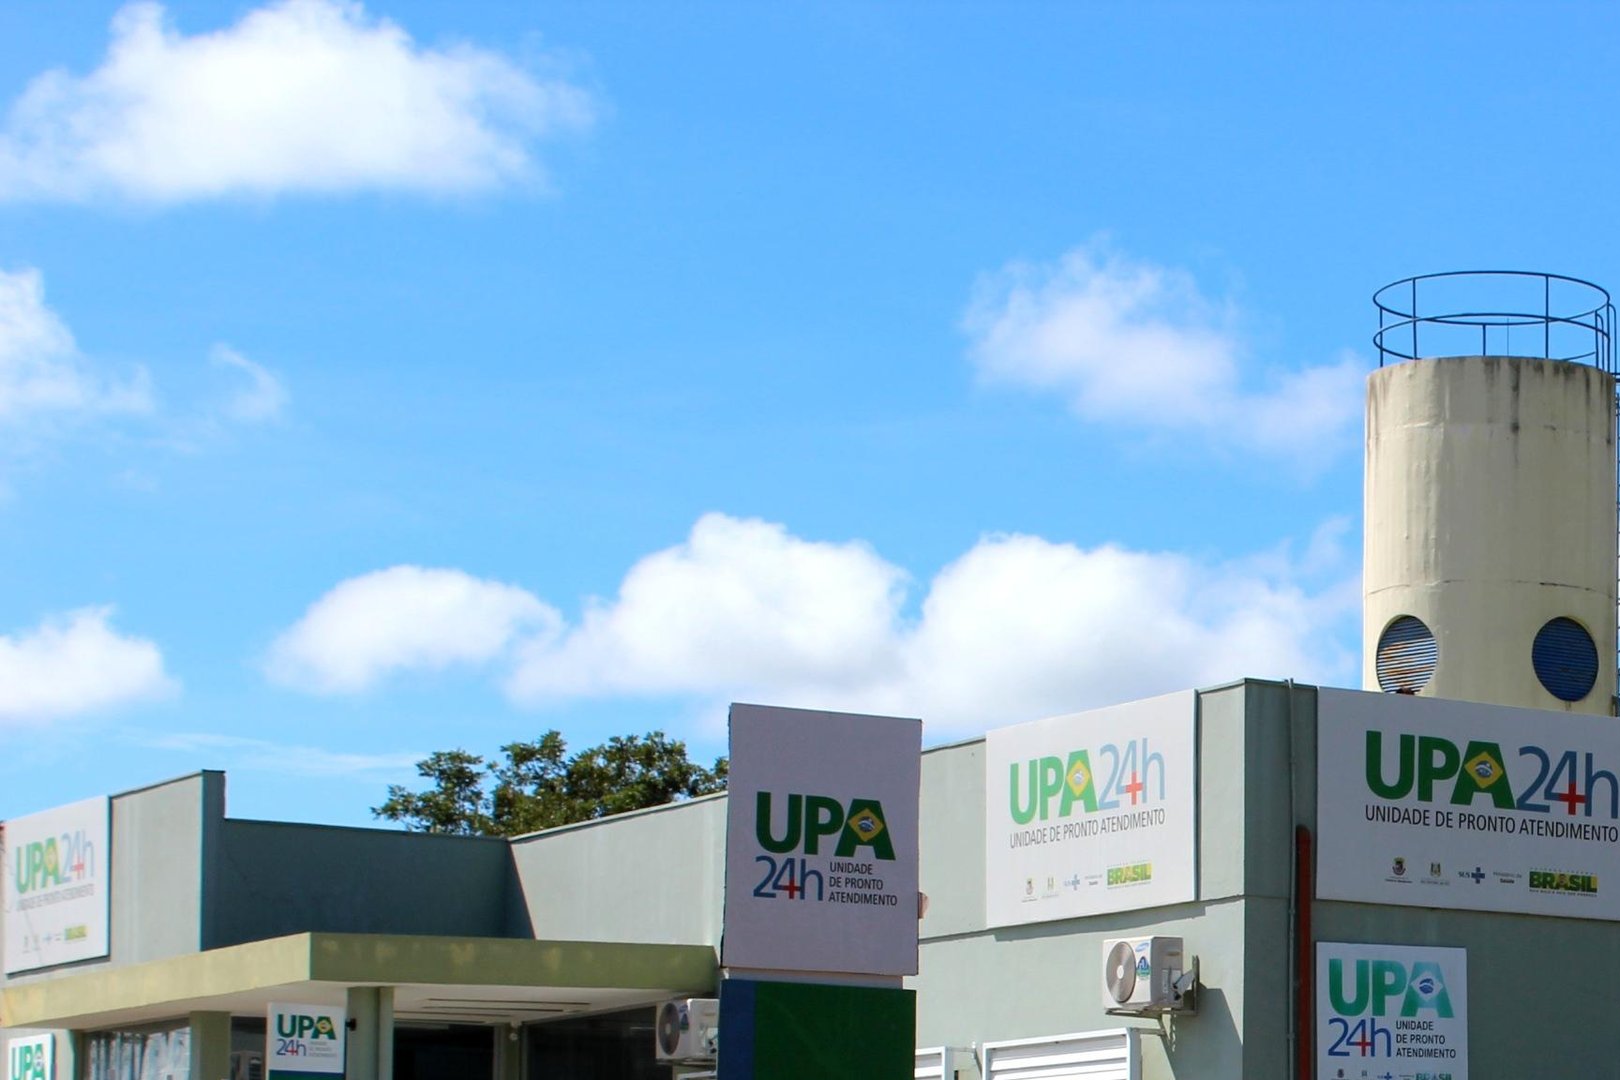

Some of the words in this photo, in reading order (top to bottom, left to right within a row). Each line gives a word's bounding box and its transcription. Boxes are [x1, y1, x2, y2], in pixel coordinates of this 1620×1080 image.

[756, 791, 896, 860] UPA
[1010, 827, 1047, 849] UNIDADE
[1050, 826, 1061, 842] DE
[1063, 820, 1098, 840] PRONTO
[1100, 808, 1165, 833] ATENDIMENTO
[1365, 804, 1430, 826] UNIDADE
[1436, 811, 1453, 829] DE
[1458, 813, 1516, 834] PRONTO
[1519, 820, 1619, 843] ATENDIMENTO
[753, 855, 824, 901] 24h
[829, 861, 873, 875] UNIDADE
[829, 876, 842, 888] DE
[845, 878, 884, 890] PRONTO
[1529, 871, 1598, 893] BRASIL
[828, 891, 898, 906] ATENDIMENTO
[1329, 958, 1455, 1018] UPA
[277, 1014, 336, 1040] UPA
[1396, 1021, 1434, 1031] UNIDADE
[276, 1038, 306, 1056] 24h
[1328, 1017, 1392, 1058] 24h
[1396, 1034, 1407, 1044] DE
[1410, 1034, 1446, 1045] PRONTO
[1396, 1048, 1456, 1059] ATENDIMENTO
